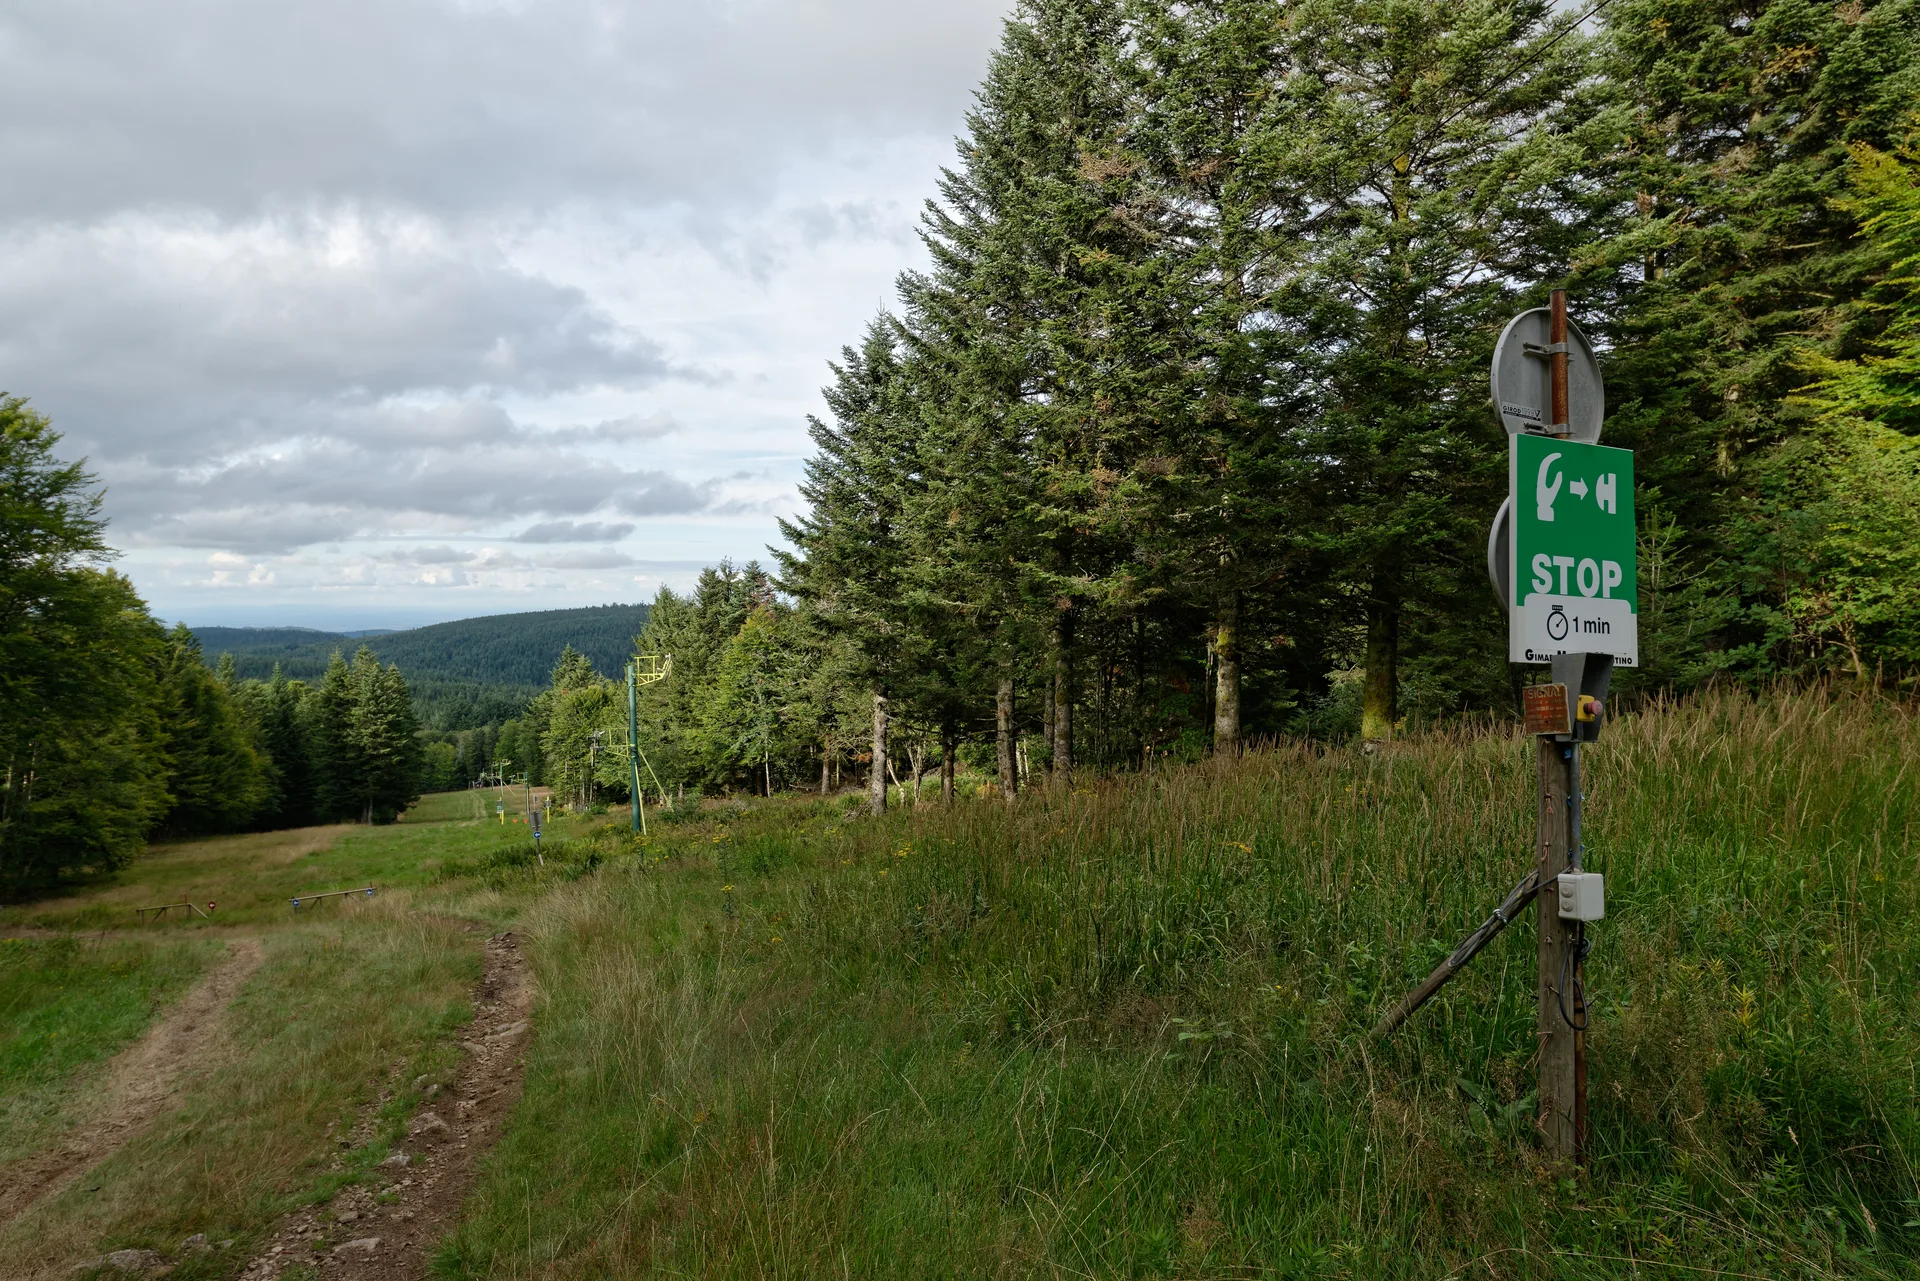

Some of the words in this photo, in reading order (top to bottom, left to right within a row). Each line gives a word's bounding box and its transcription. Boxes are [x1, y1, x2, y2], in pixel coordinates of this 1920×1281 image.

[1503, 405, 1521, 414] GIROD
[1531, 553, 1623, 599] STOP
[1572, 616, 1579, 633] 1
[1583, 617, 1611, 635] min
[1527, 687, 1562, 699] SIGNAL
